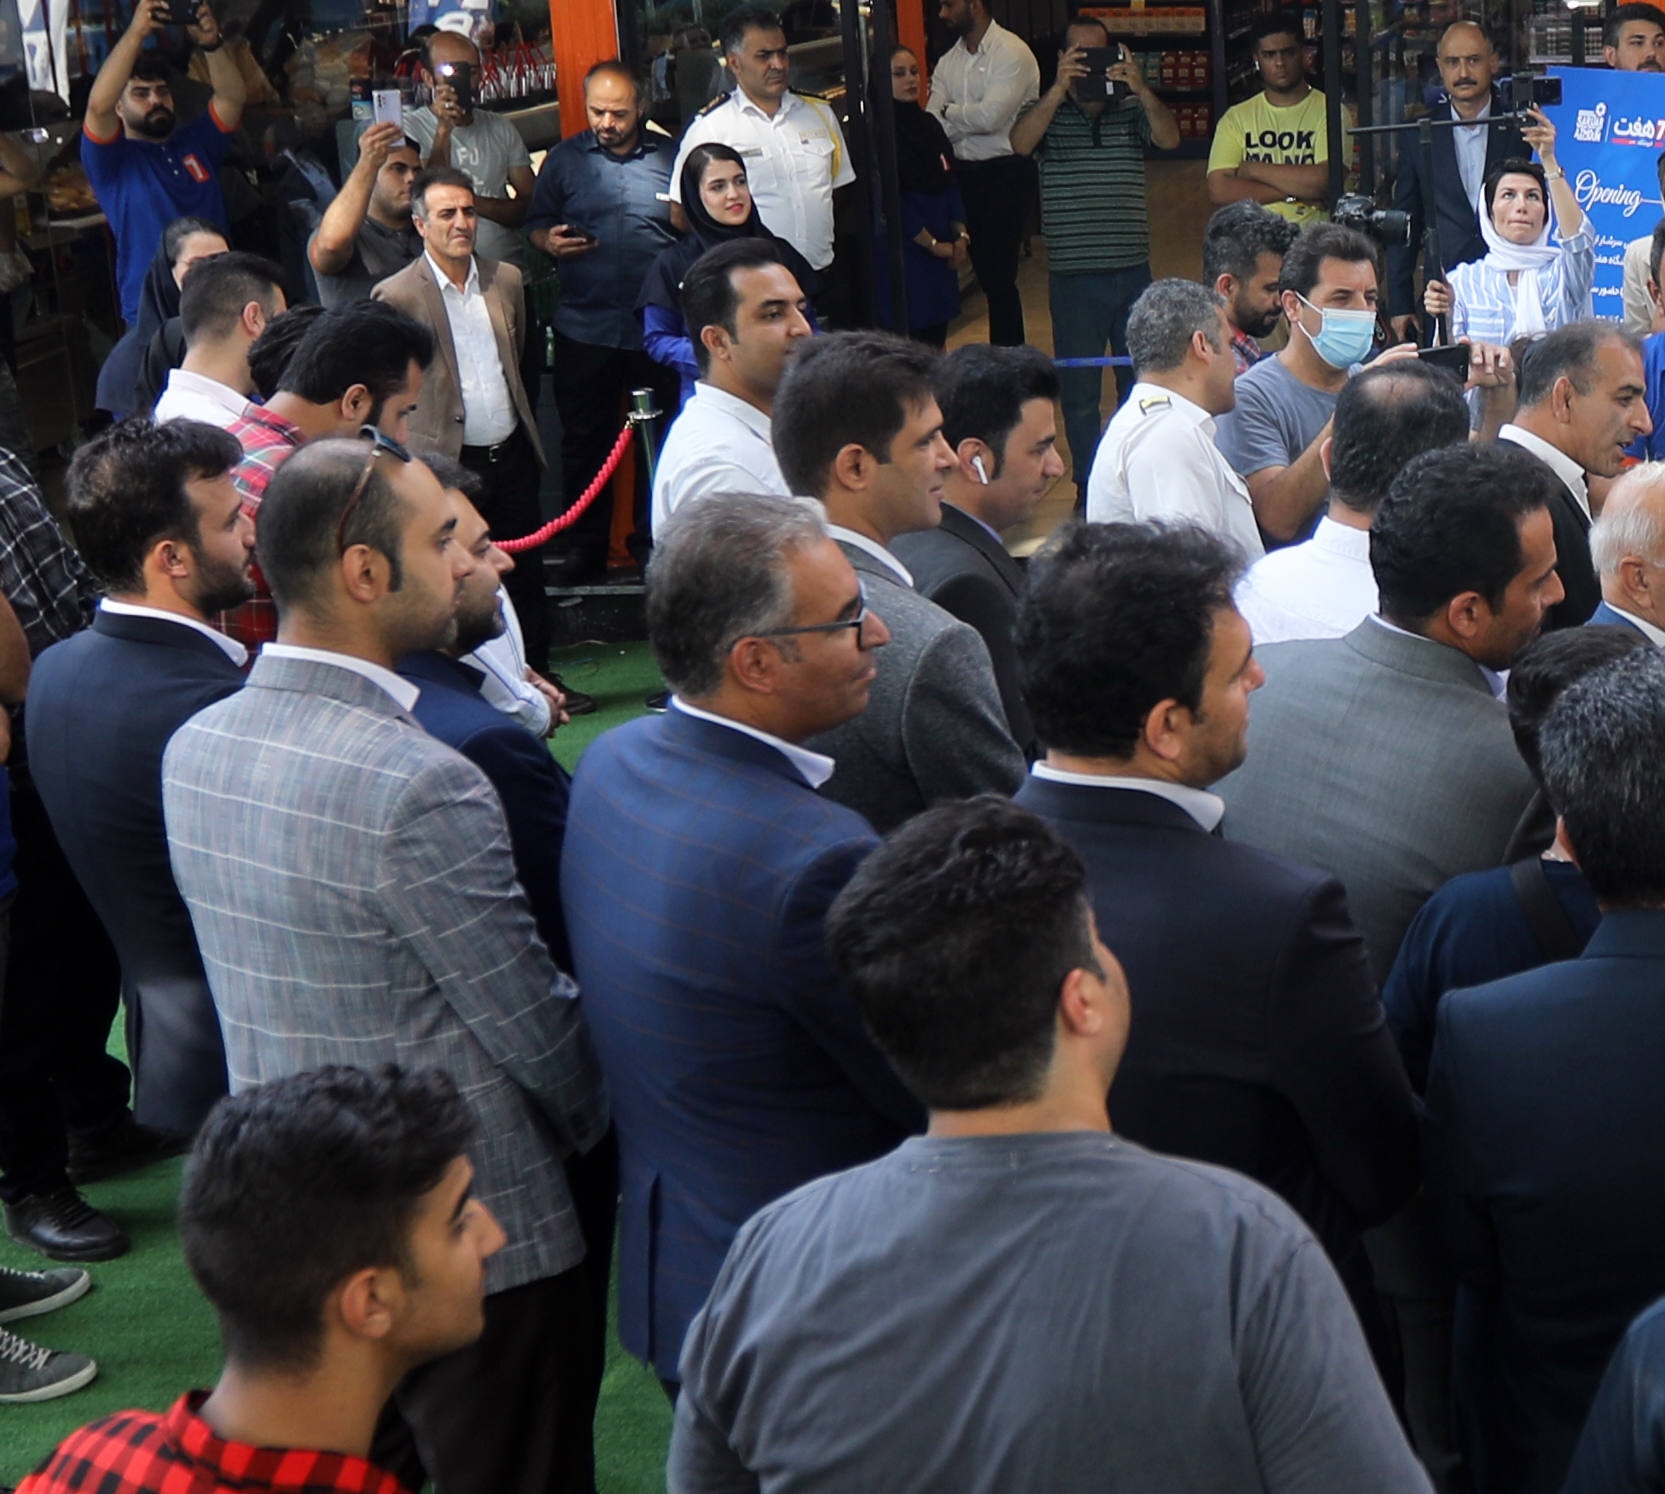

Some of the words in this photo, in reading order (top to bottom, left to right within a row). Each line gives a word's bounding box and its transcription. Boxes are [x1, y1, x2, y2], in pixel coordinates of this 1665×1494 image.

[1613, 116, 1656, 139] هفت
[1245, 130, 1316, 151] LOOK
[1575, 169, 1643, 218] Opening
